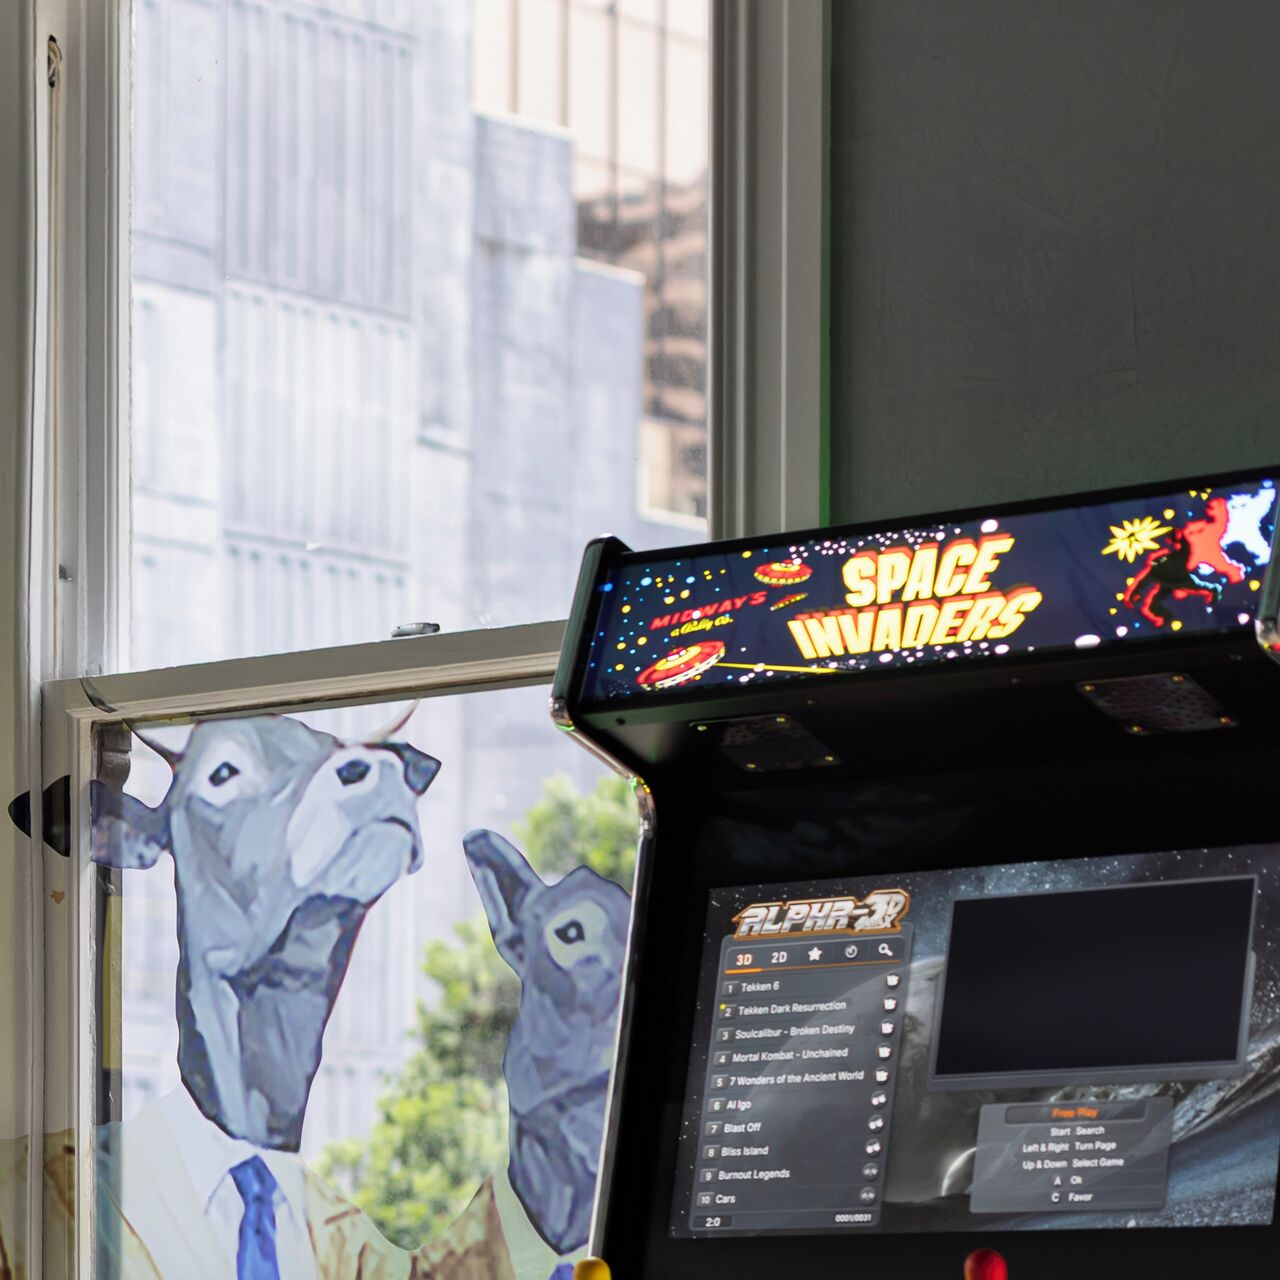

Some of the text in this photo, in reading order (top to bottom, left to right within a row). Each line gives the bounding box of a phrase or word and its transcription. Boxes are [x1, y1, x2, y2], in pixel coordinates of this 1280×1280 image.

[842, 533, 1015, 608] SPACE
[787, 587, 1042, 660] INVADERS
[736, 952, 788, 966] 3D 2D
[741, 982, 771, 992] Tekken
[773, 981, 780, 990] 6
[725, 1001, 846, 1017] 2 Tekken Dark Resurrection
[722, 1031, 729, 1040] 3
[735, 1028, 782, 1040] Soulcalibur
[790, 1026, 820, 1036] Broken
[822, 1024, 855, 1035] Destiny
[719, 1055, 726, 1064] 4
[732, 1052, 759, 1063] Mortal
[761, 1051, 794, 1061] Kombat
[802, 1048, 849, 1059] Unchained
[716, 1070, 865, 1088] 5 7 Wonders of the Ancient World
[1051, 1106, 1098, 1118] Free Play
[711, 1122, 761, 1134] 7 Blast Off
[1050, 1125, 1105, 1137] Start Search
[721, 1146, 742, 1157] Bliss
[743, 1145, 769, 1156] Island
[1022, 1141, 1117, 1153] Left & Right Turn Page
[1022, 1157, 1124, 1171] Up & Down Select Game
[705, 1169, 790, 1181] 9 Burnout Legends
[1054, 1175, 1083, 1186] A Ok
[701, 1194, 736, 1204] 10 Cars
[1051, 1192, 1093, 1203] C Favor
